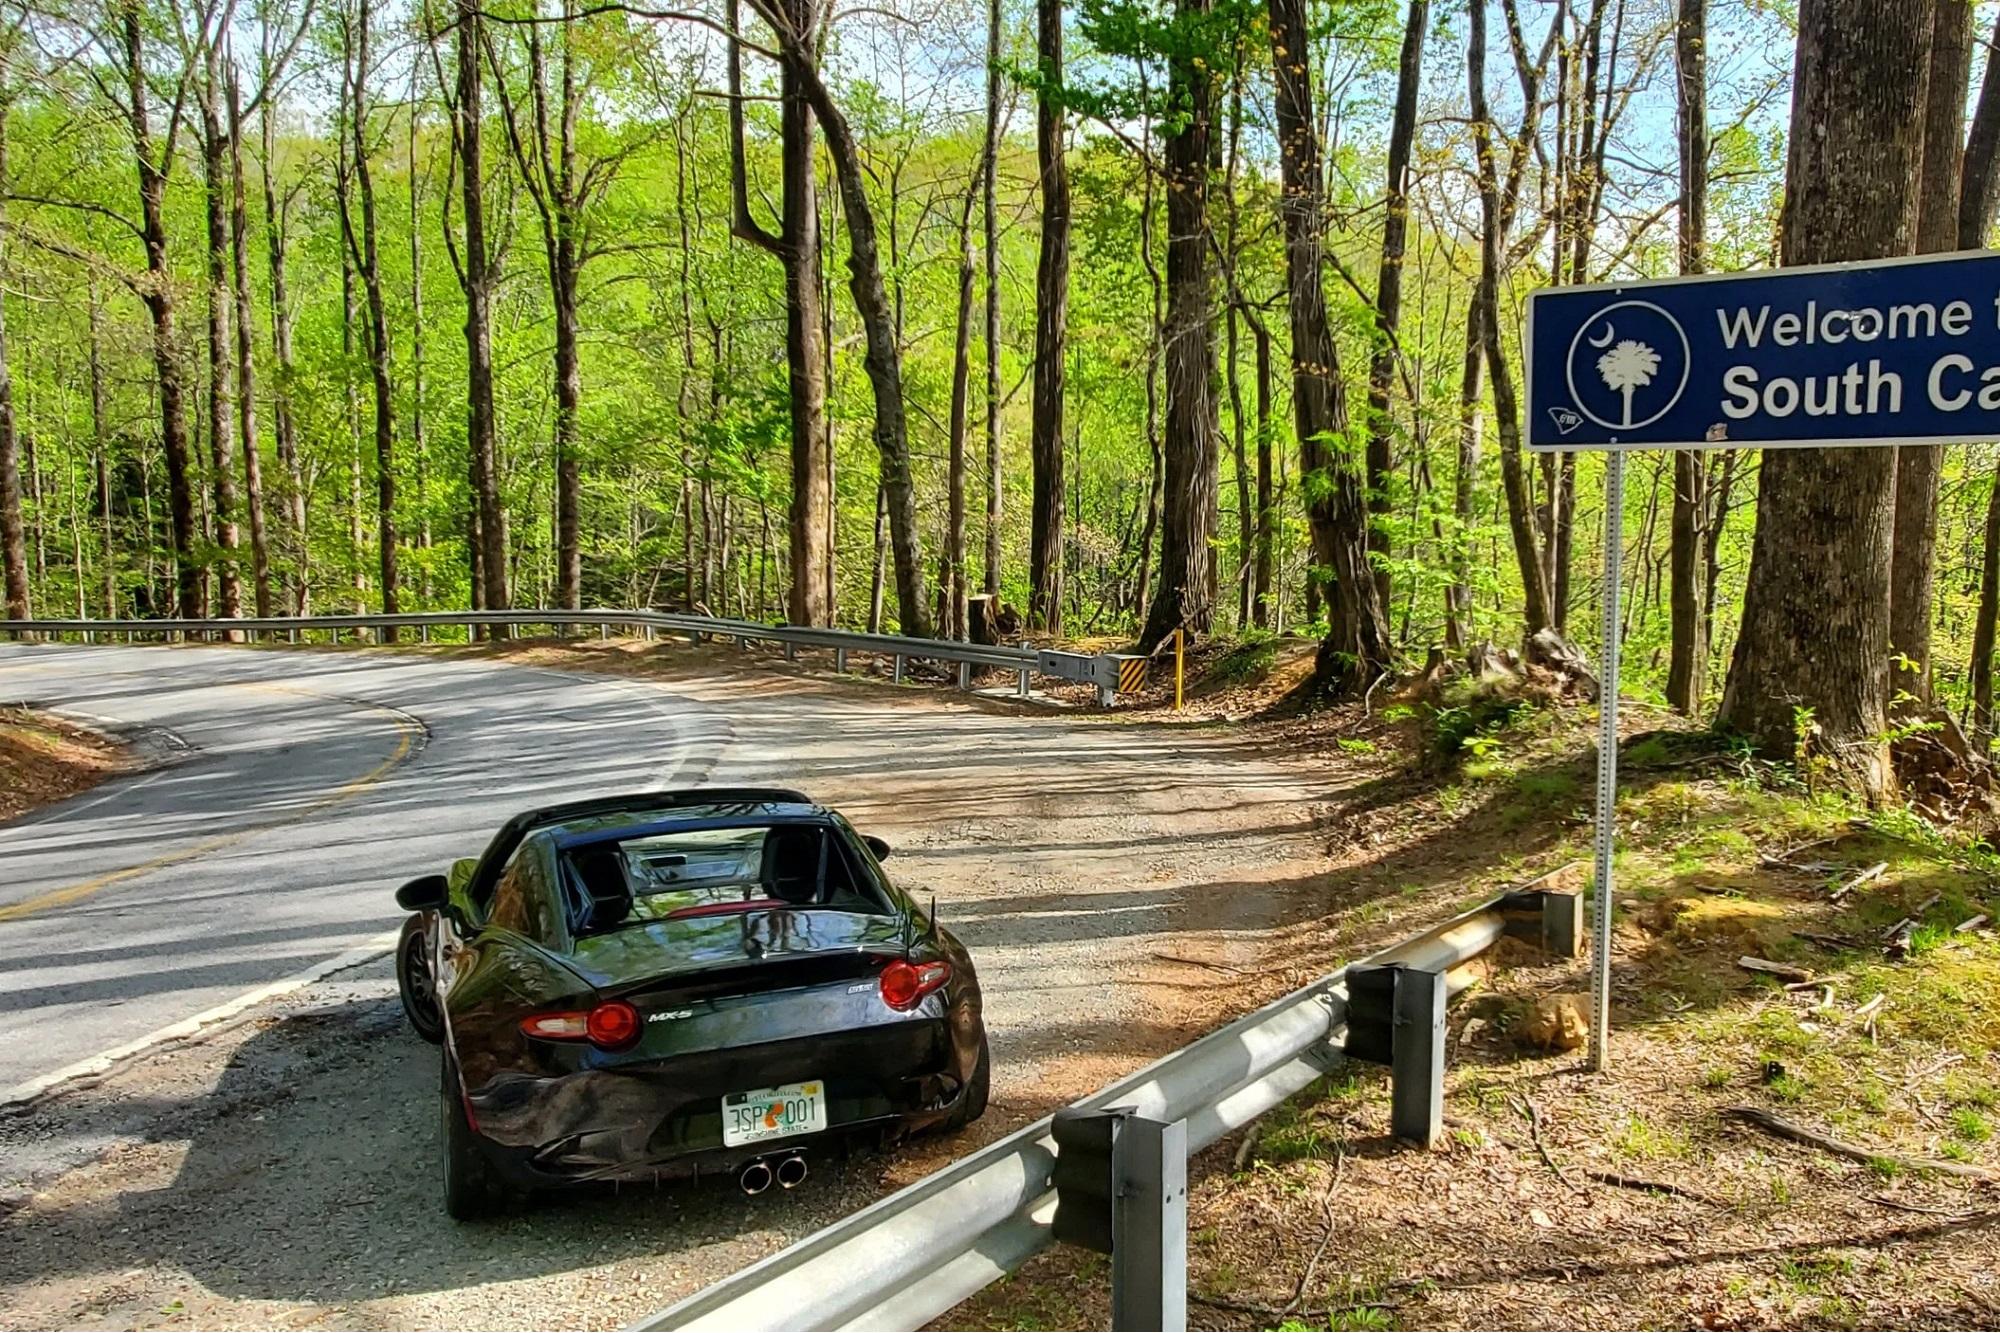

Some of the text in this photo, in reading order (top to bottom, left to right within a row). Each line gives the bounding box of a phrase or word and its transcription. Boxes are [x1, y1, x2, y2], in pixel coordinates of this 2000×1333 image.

[1716, 299, 1972, 350] Welcome
[1720, 358, 1902, 420] South
[648, 1009, 693, 1022] MX-5
[786, 1097, 815, 1125] 001
